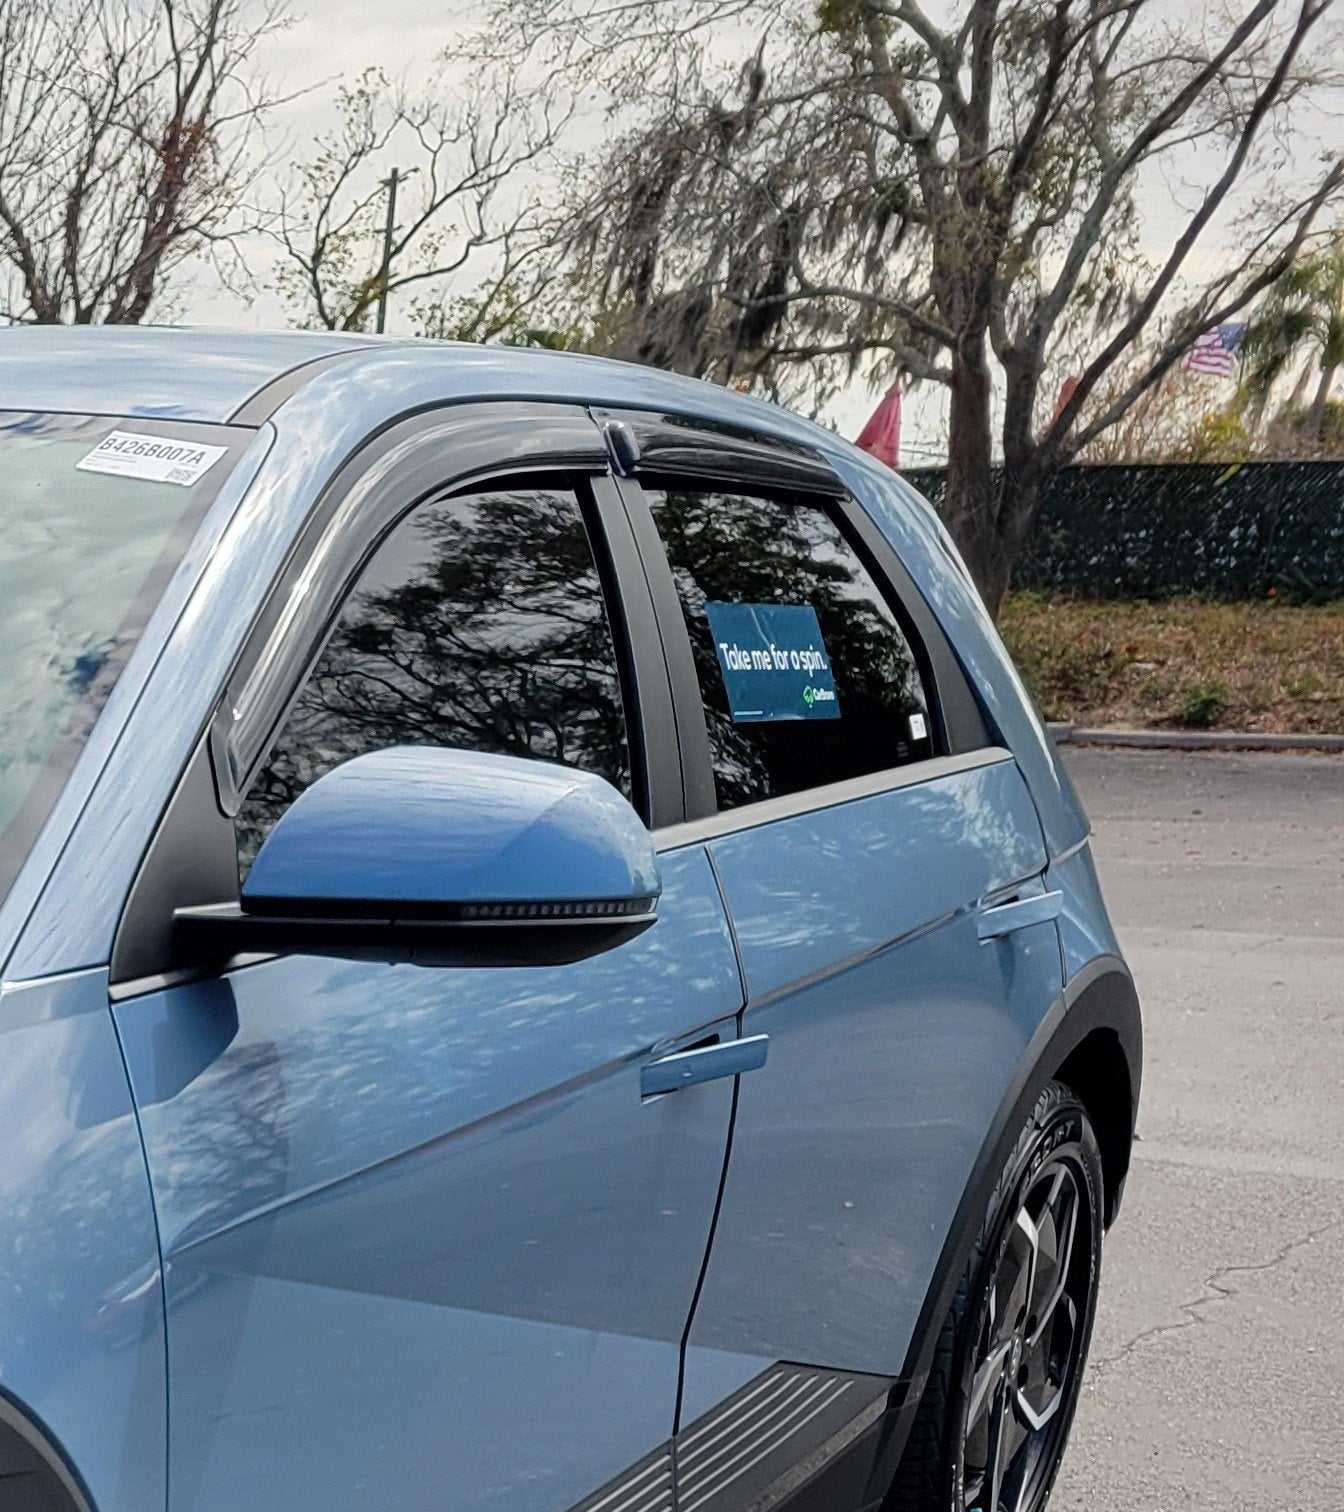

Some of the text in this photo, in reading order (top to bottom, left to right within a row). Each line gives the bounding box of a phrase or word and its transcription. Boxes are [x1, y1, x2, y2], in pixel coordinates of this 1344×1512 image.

[99, 438, 206, 465] B426B007A
[719, 643, 828, 678] Take me for a spin.
